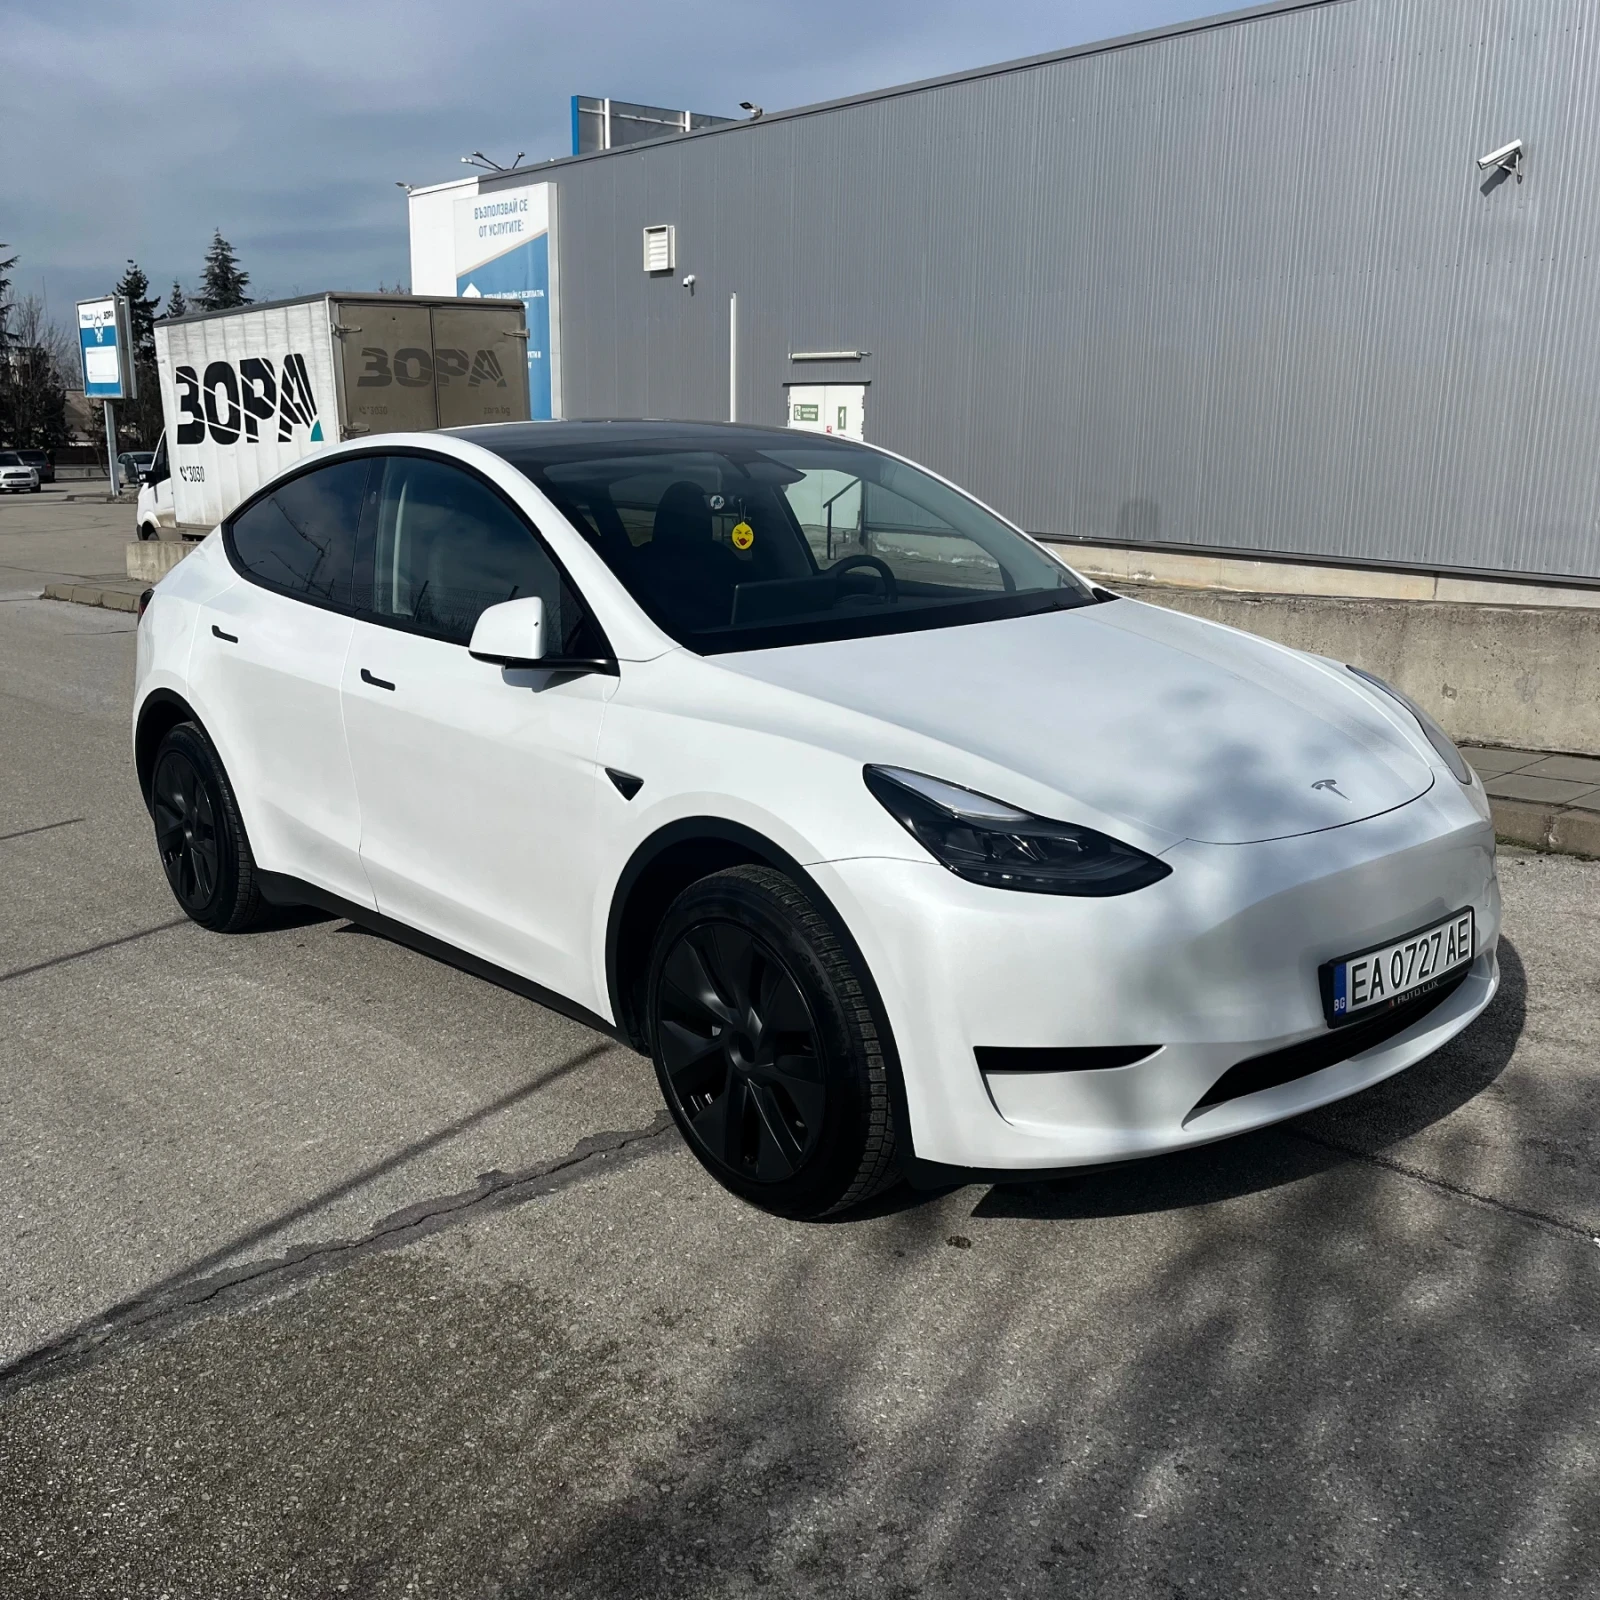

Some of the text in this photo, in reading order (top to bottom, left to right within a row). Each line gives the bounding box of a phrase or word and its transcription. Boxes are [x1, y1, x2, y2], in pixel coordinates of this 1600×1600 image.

[474, 198, 528, 220] ВЪЗПОЛЗВАЙ СЕ
[478, 219, 524, 238] ОТ УСЛУГИТЕ:
[356, 347, 508, 388] ЗОРА
[175, 353, 324, 445] ЗОРА
[1351, 917, 1469, 1007] EA 0727 AE
[1333, 996, 1346, 1012] BG
[1397, 979, 1439, 1004] AUTO LUX
